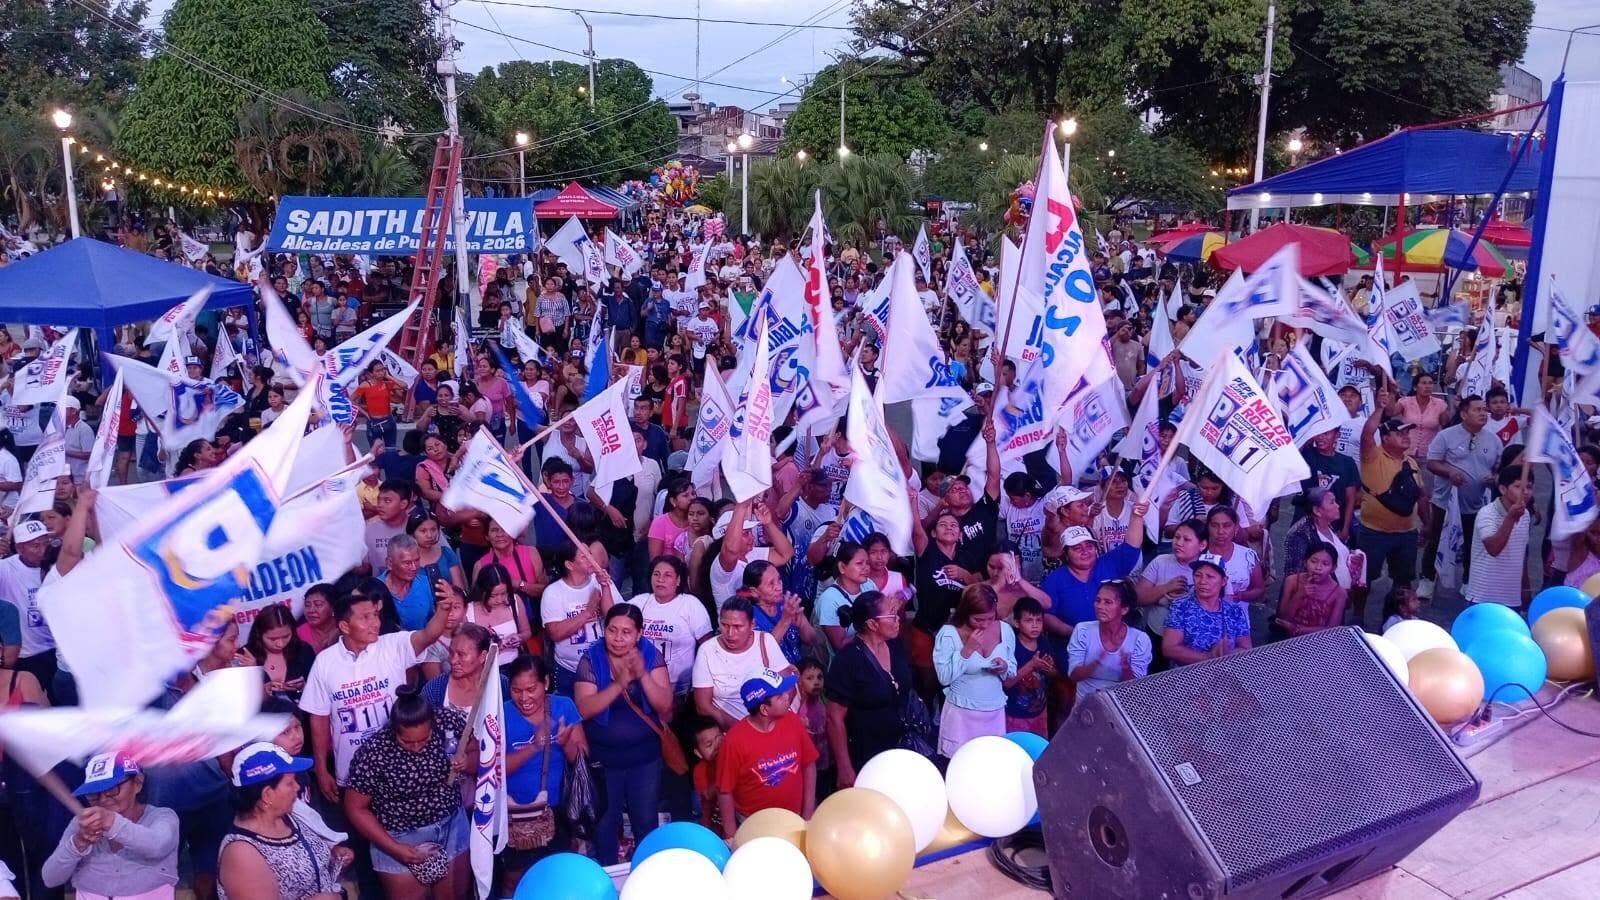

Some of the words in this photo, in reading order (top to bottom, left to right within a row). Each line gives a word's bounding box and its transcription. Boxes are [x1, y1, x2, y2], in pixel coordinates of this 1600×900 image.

[285, 209, 407, 236] SADITH
[280, 235, 371, 251] Alcaldesa
[374, 236, 395, 250] de
[484, 234, 525, 250] 2026
[1232, 377, 1257, 398] PEPE
[1241, 408, 1285, 447] ROJAS
[1250, 399, 1292, 445] NELDA
[1239, 447, 1259, 466] 1
[240, 545, 323, 603] ALDEON
[647, 623, 674, 633] ROJAS
[333, 687, 361, 702] NELDA
[362, 678, 389, 694] ROJAS
[343, 690, 382, 706] SENADORA
[362, 707, 371, 728] 1
